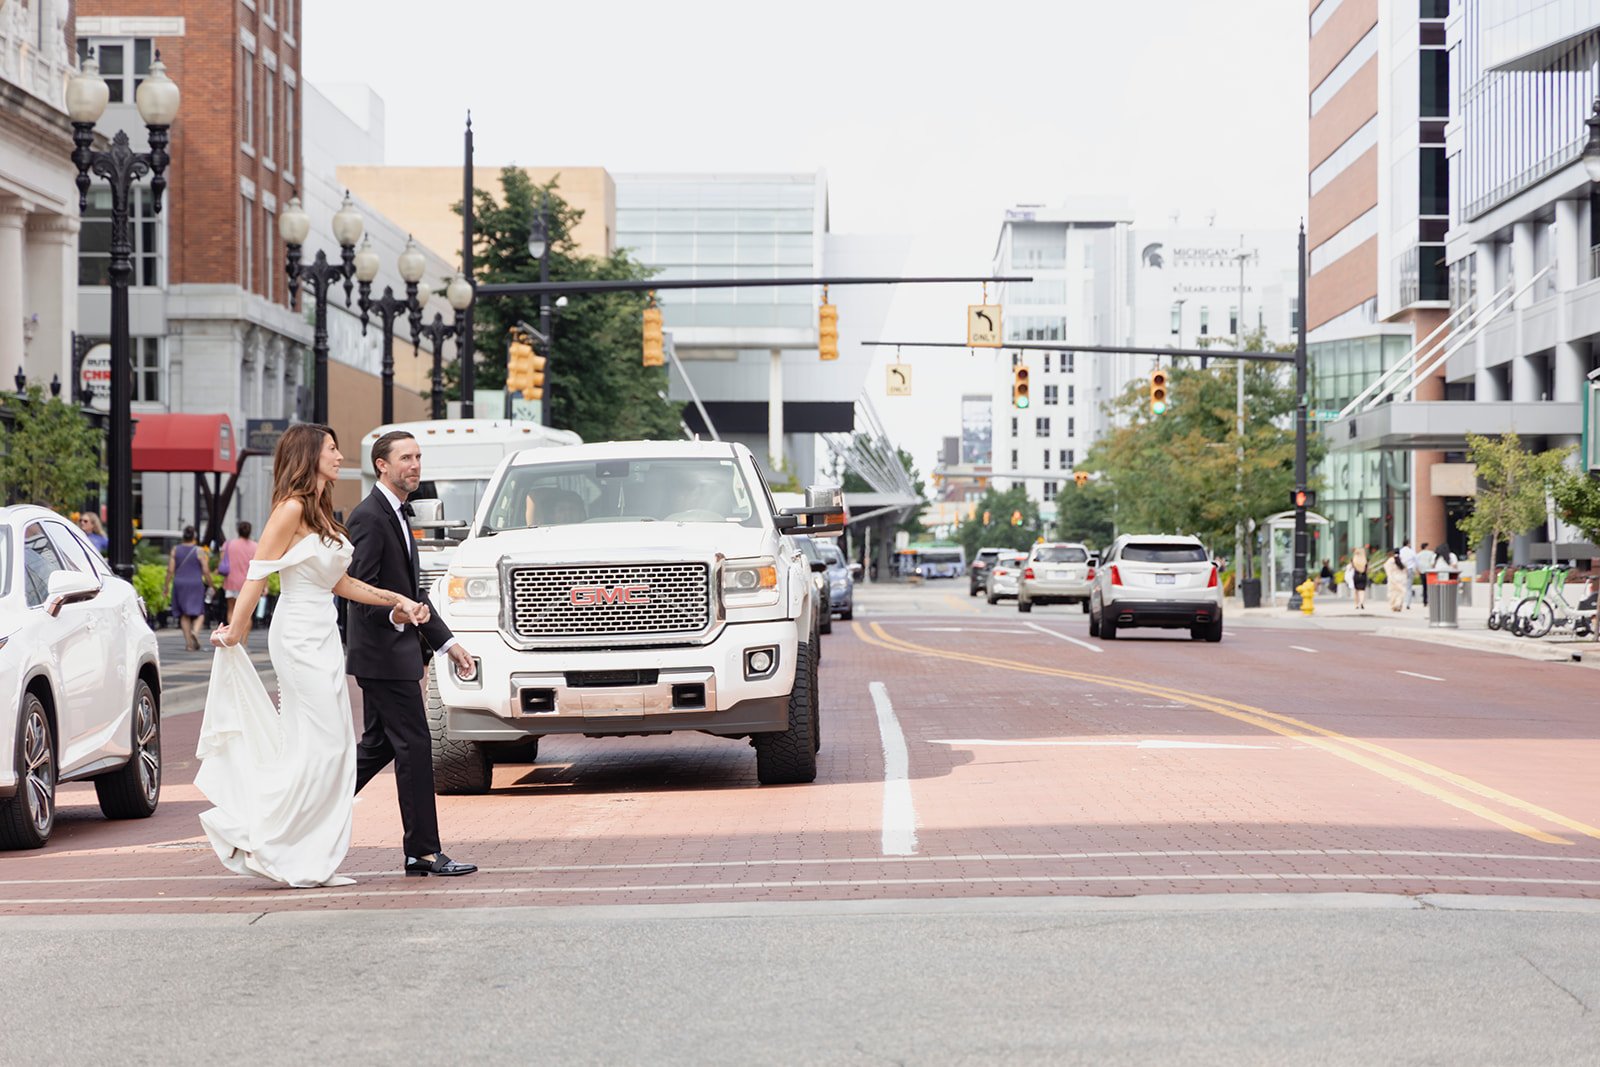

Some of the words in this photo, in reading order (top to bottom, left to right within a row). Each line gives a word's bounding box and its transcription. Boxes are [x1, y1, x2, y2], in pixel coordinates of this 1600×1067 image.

[1173, 248, 1228, 256] MICHIGAN
[973, 333, 996, 341] ONLY
[83, 370, 111, 381] CHR
[570, 585, 650, 605] GMC
